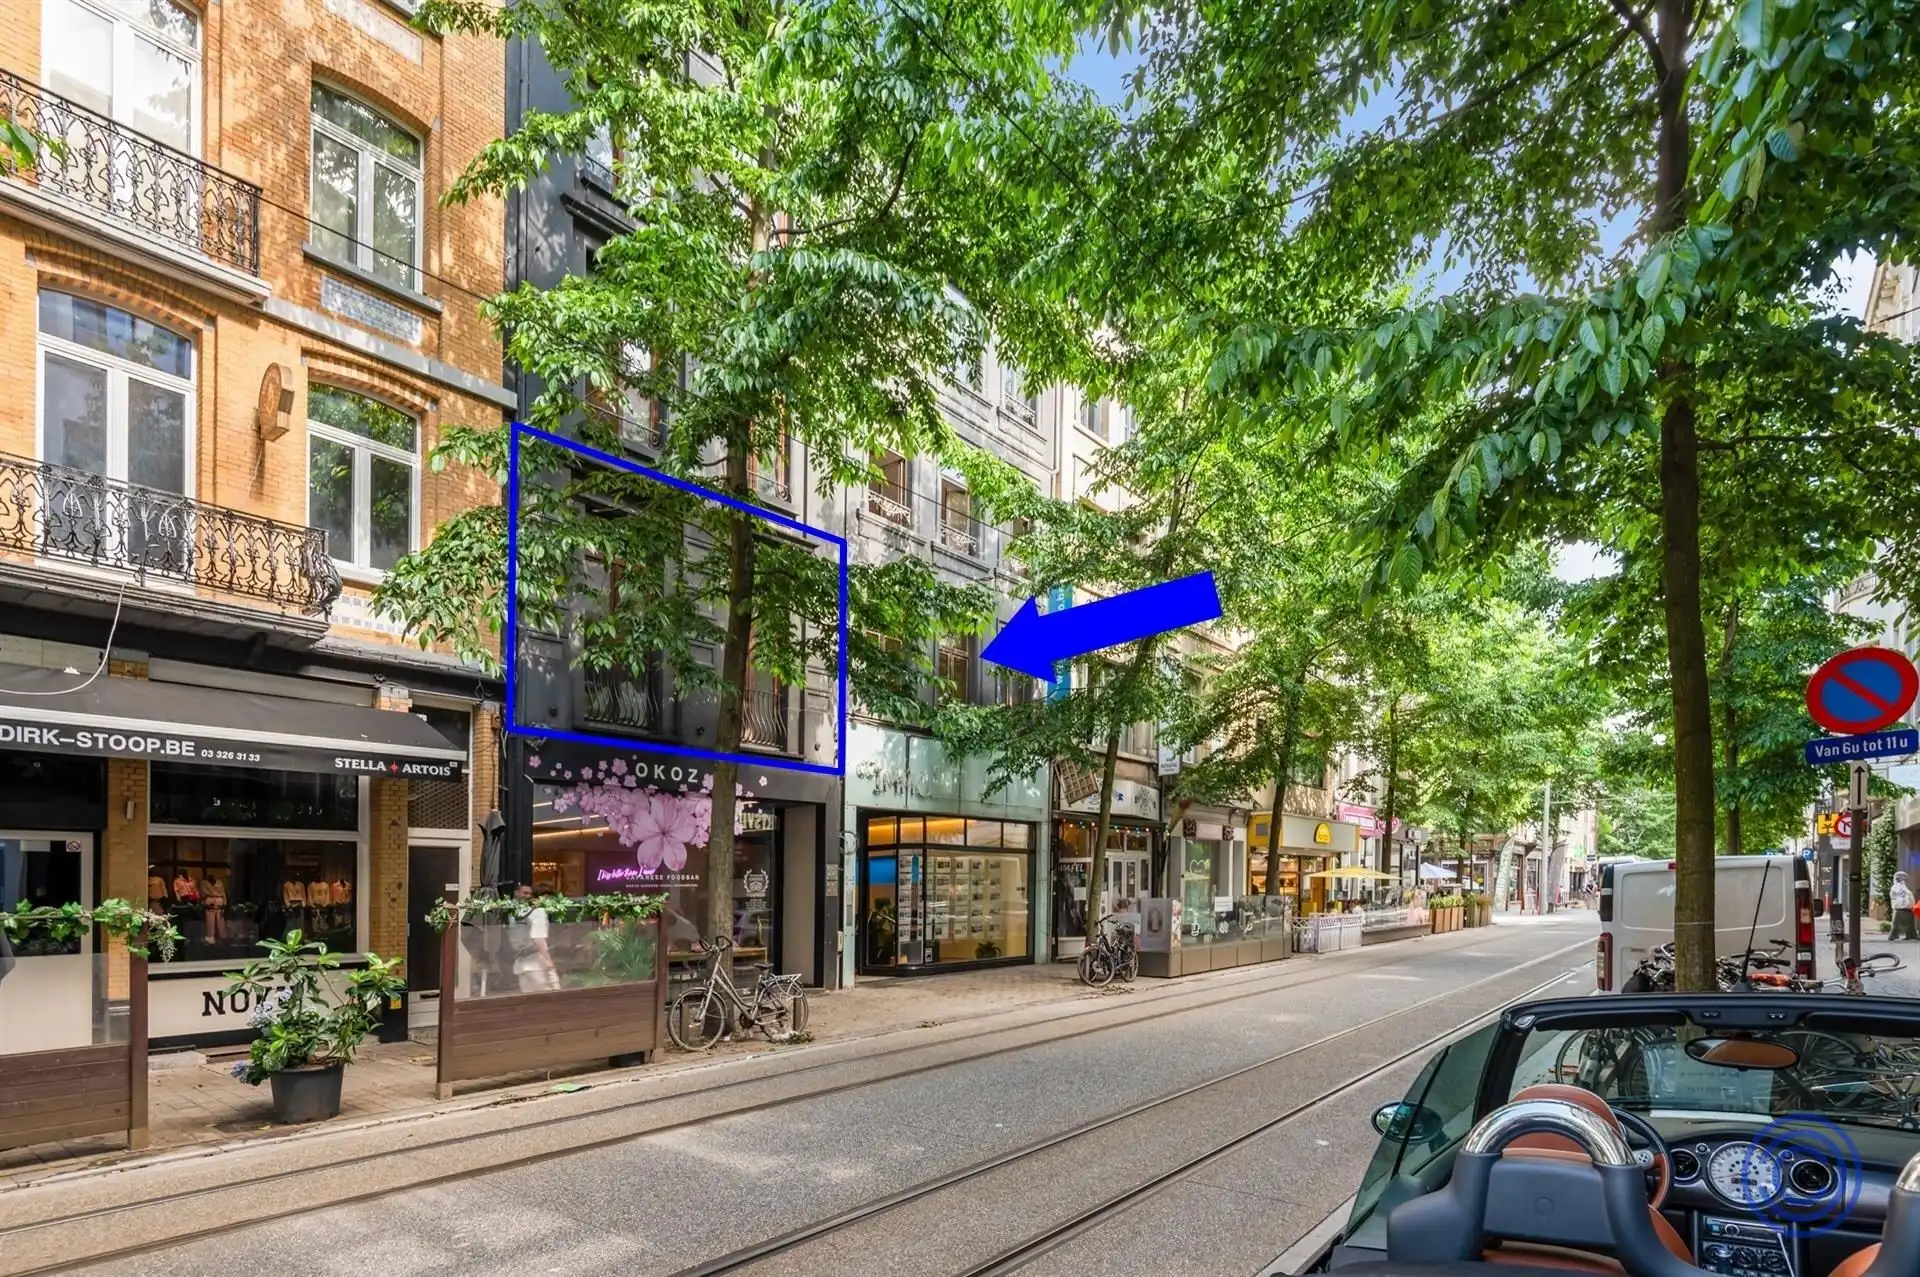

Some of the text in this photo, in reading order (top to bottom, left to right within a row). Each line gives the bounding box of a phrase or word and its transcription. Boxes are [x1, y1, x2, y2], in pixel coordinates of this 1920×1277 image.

[201, 749, 260, 762] 03 326 31 33
[1815, 745, 1839, 757] Van
[1842, 742, 1859, 754] 6u
[1863, 740, 1882, 751] tot
[334, 757, 451, 776] STELLA ARTOIS
[635, 762, 698, 783] OKOZ
